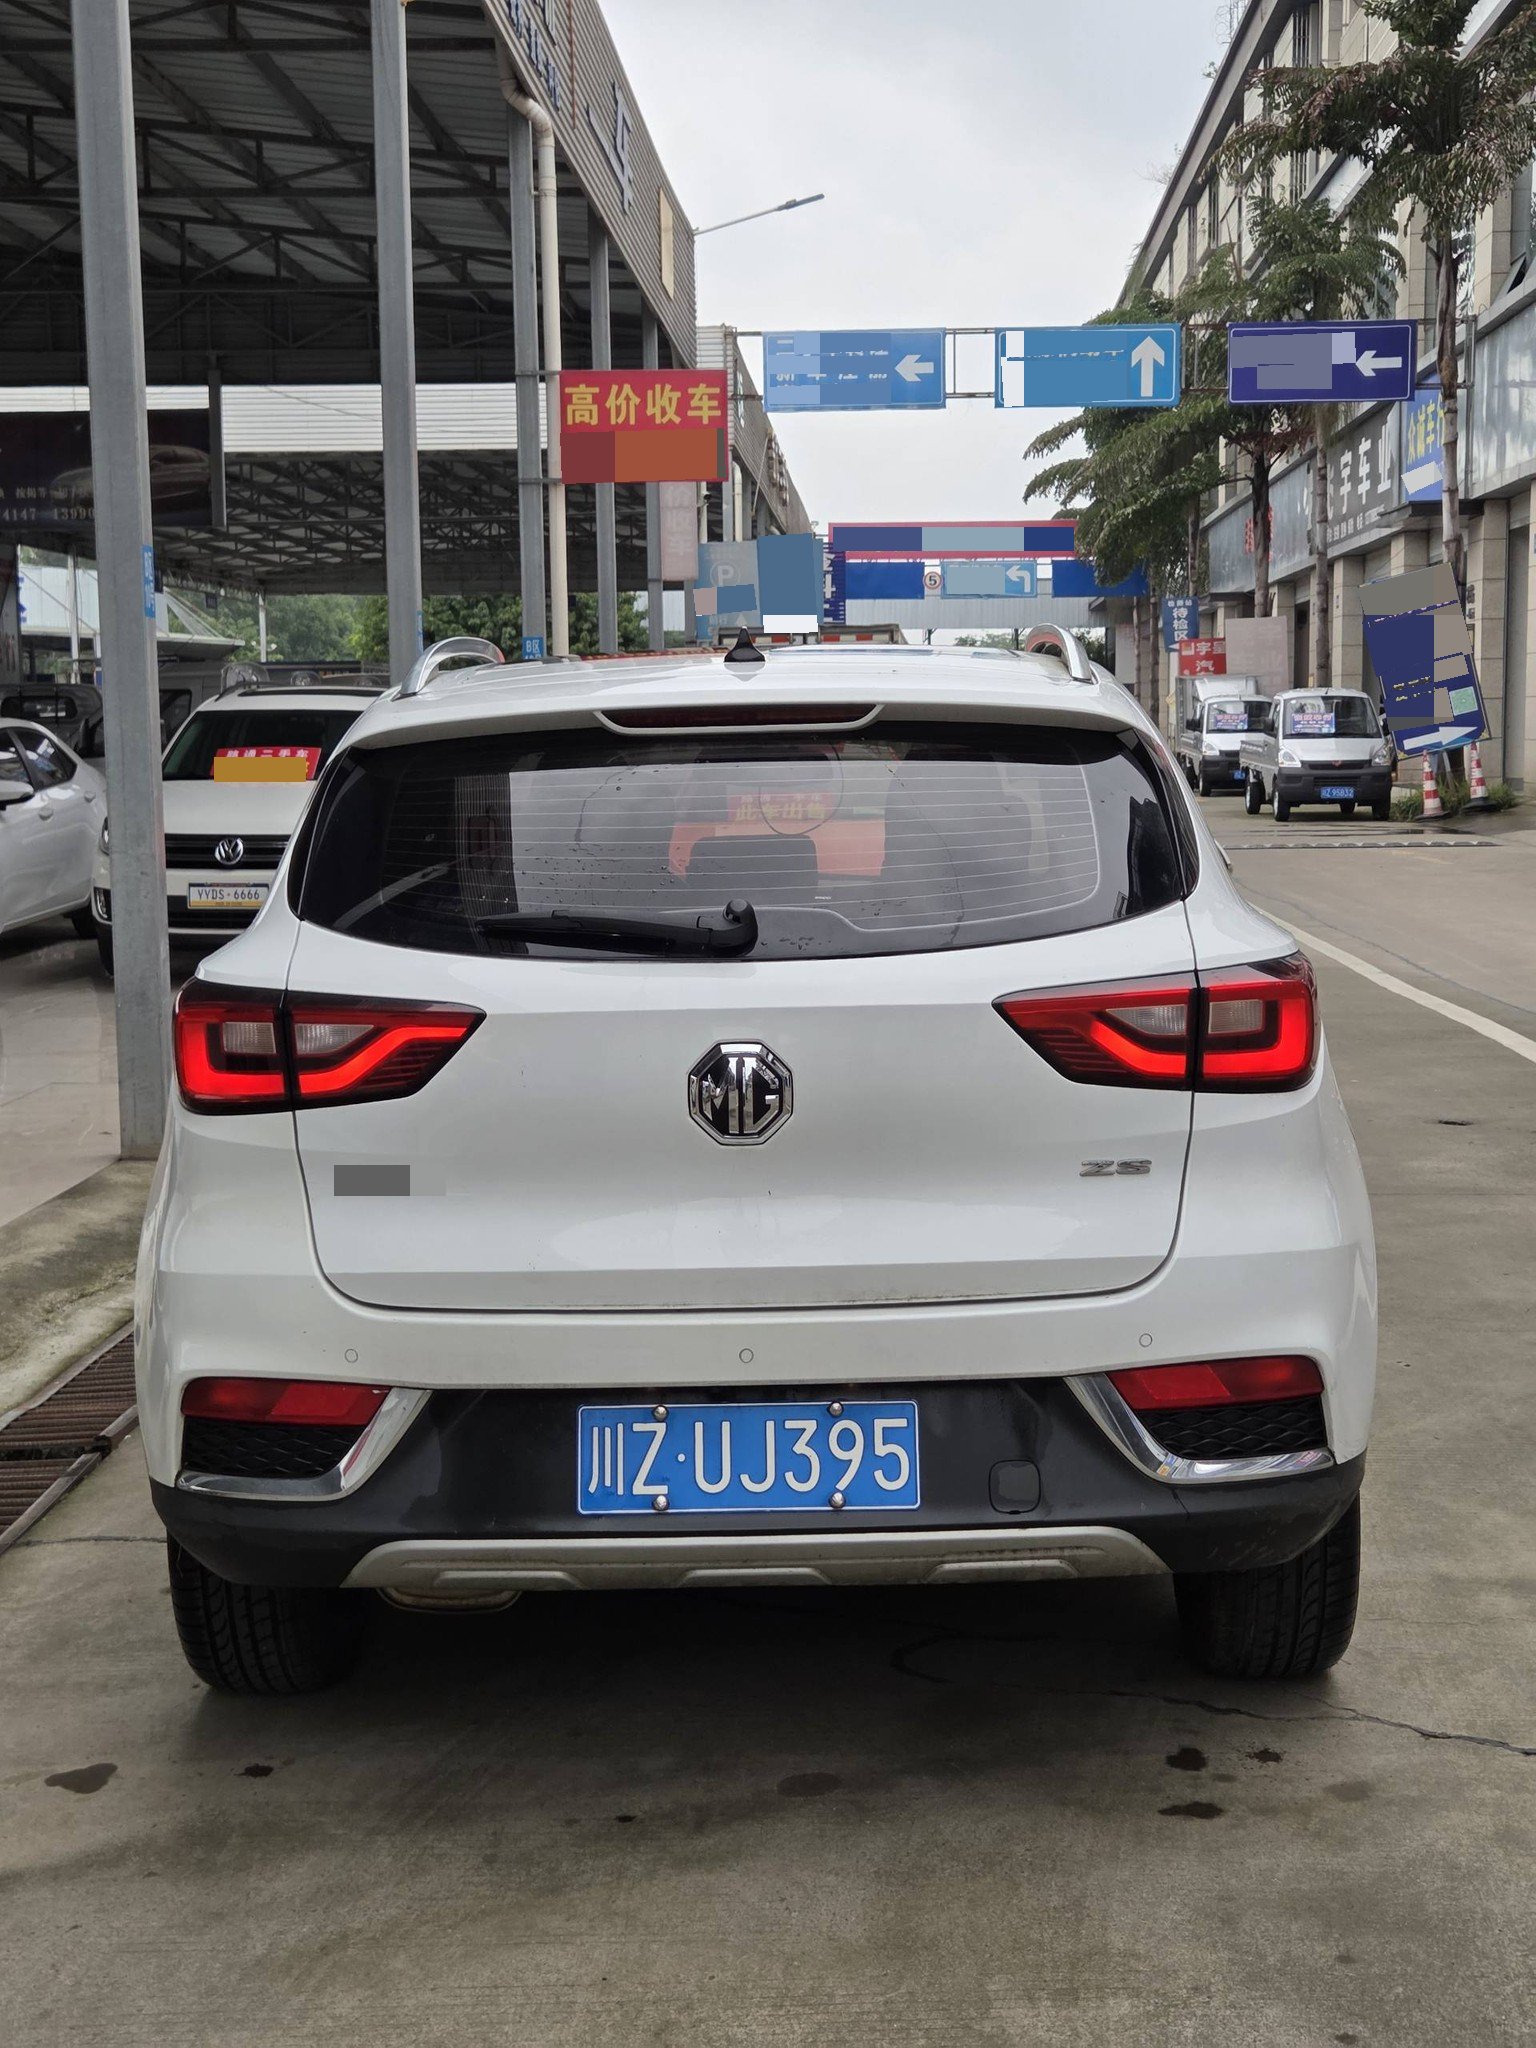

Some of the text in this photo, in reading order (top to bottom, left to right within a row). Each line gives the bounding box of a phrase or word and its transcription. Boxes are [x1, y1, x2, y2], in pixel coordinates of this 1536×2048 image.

[564, 383, 722, 426] 高价收车
[928, 575, 938, 586] 5
[700, 1055, 781, 1135] MG
[1079, 1158, 1153, 1178] ZS
